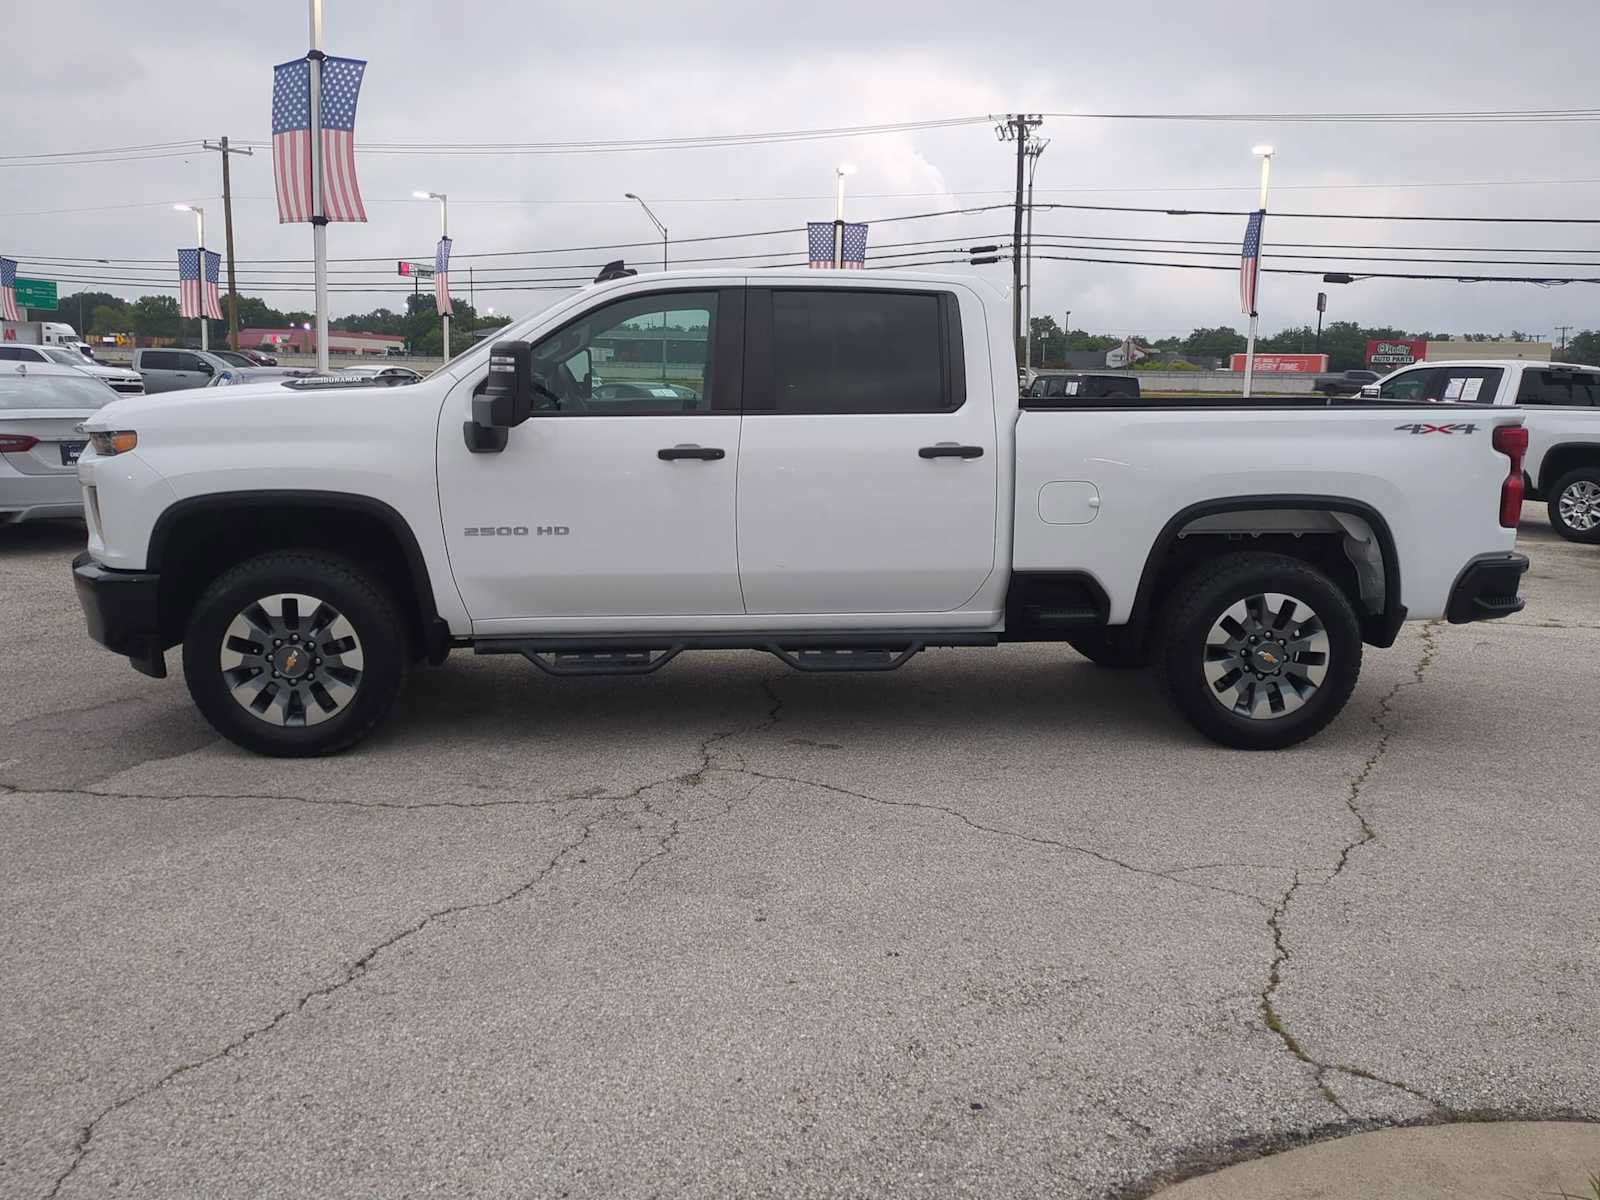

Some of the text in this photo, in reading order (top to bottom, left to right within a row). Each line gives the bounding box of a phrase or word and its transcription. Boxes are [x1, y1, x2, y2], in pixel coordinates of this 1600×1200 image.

[322, 375, 362, 384] DURAMAX
[463, 526, 570, 537] 2500 HD
